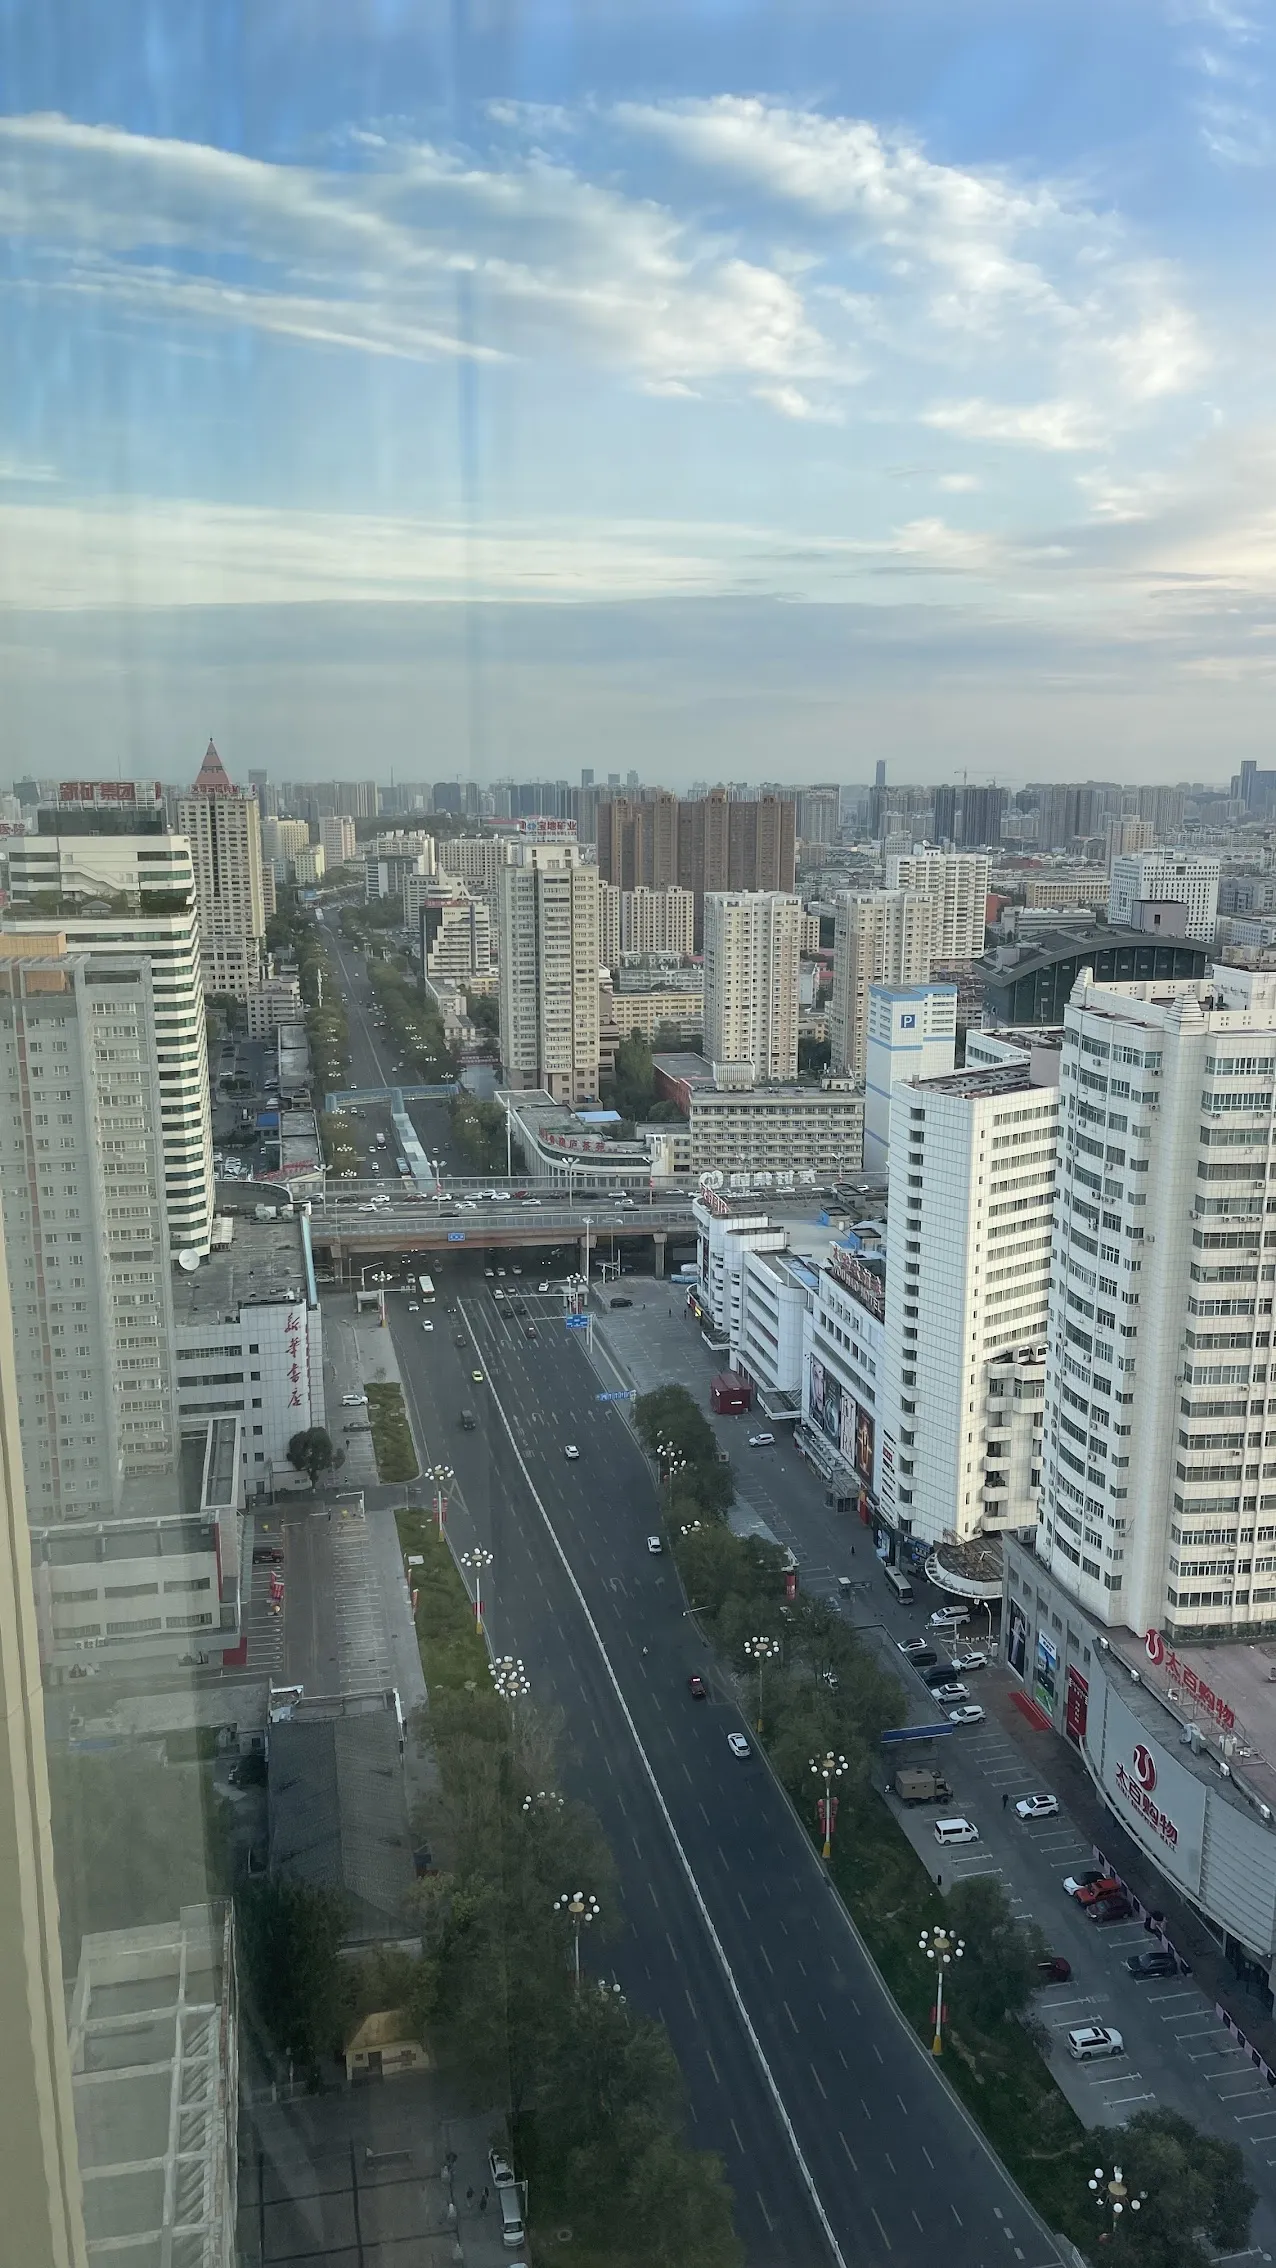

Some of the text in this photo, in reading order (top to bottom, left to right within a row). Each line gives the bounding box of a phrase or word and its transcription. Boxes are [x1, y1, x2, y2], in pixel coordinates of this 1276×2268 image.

[903, 1015, 913, 1028] P
[1165, 1650, 1235, 1729] 太百购物
[1115, 1761, 1178, 1845] 太百购物
